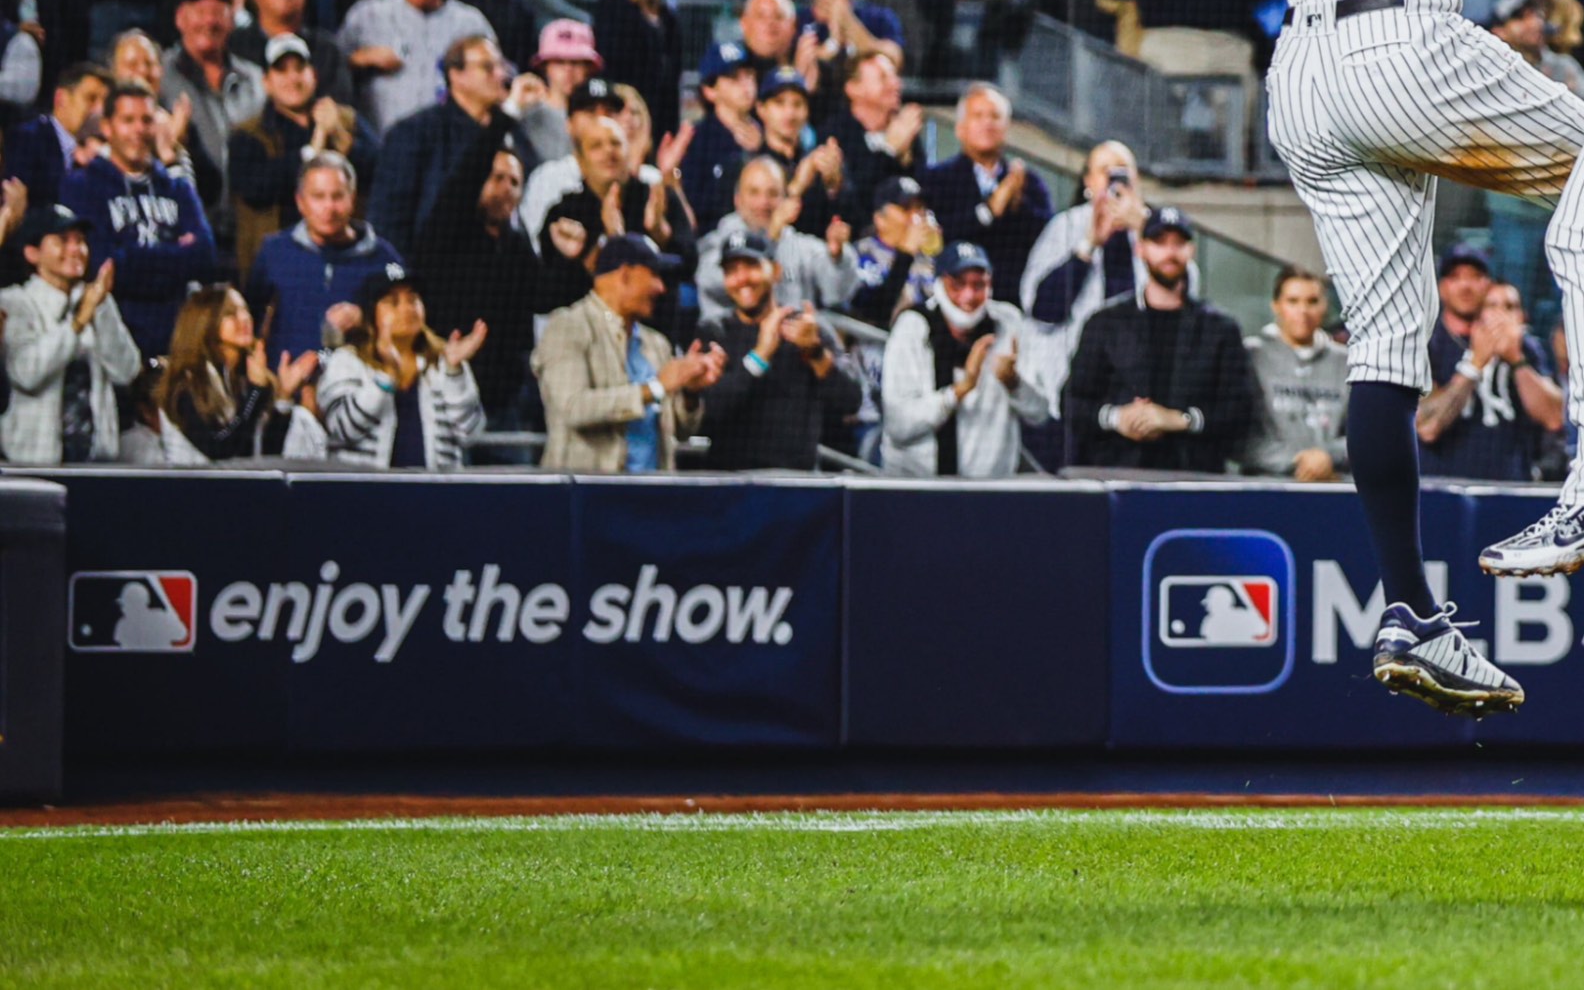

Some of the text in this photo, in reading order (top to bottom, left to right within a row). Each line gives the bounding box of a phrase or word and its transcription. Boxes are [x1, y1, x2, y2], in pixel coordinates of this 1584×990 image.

[209, 560, 794, 663] enjoy the show.
